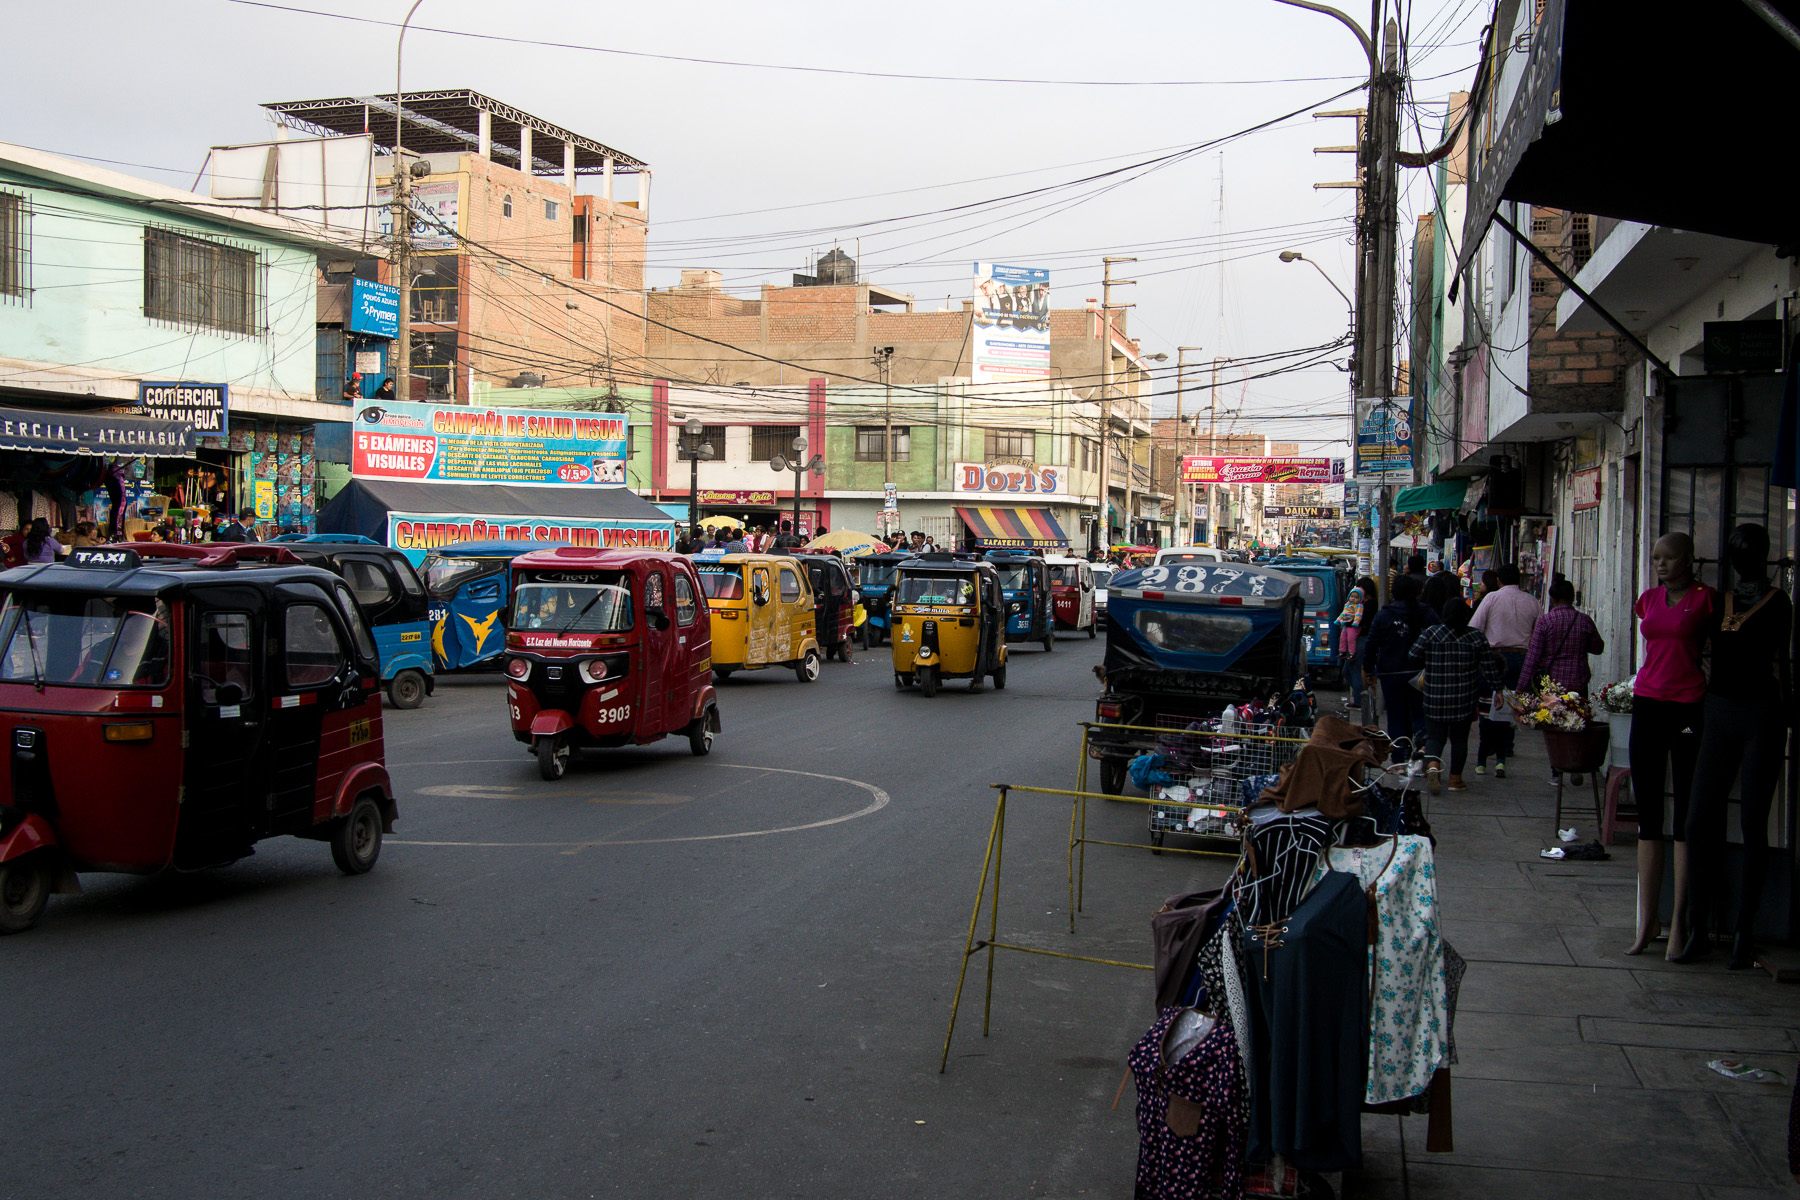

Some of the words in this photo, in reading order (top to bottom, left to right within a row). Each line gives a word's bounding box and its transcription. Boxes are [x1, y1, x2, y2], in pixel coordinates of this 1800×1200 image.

[381, 297, 398, 306] AZULES
[369, 306, 397, 322] Prymera
[146, 388, 221, 406] COMERCIAL
[434, 411, 504, 437] CAMPAÑA
[506, 415, 526, 438] DE
[527, 415, 574, 439] SALUD
[575, 418, 626, 441] VISUAL
[358, 434, 368, 450] 5
[370, 434, 434, 454] EXÁMENES
[367, 453, 426, 472] VISUALES
[1332, 463, 1345, 475] 02
[703, 490, 737, 499] Banana
[748, 491, 772, 502] Split
[1284, 507, 1318, 516] DAILYN
[397, 520, 501, 549] CAMPAÑA
[504, 525, 530, 542] DE
[534, 526, 600, 547] SALUD
[602, 528, 670, 548] VISUAL
[983, 538, 1026, 547] ZAPATERIA
[75, 552, 126, 564] TAXI
[553, 638, 568, 647] Nuevo
[568, 638, 592, 648] Horizonte
[597, 704, 631, 723] 3903
